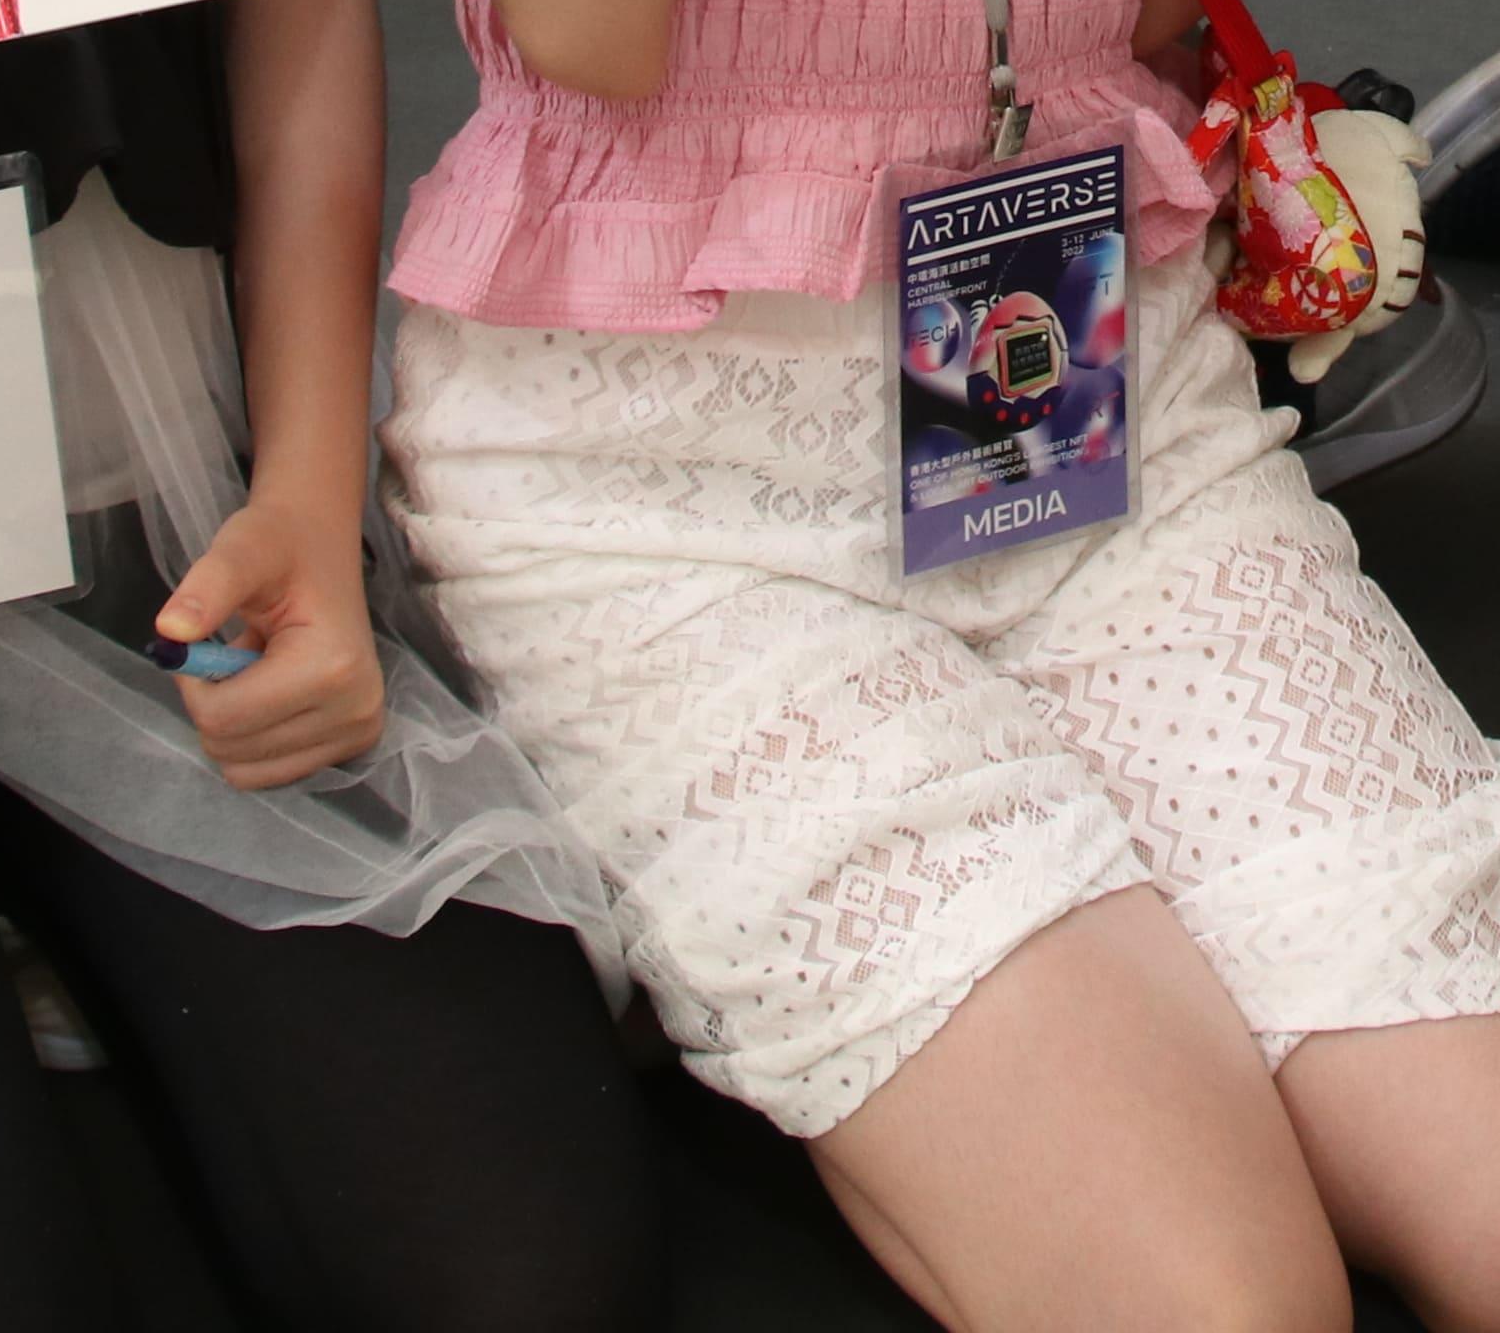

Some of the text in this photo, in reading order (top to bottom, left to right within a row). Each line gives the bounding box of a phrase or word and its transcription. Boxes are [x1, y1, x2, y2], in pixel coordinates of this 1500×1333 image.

[908, 171, 1115, 250] ARTAVERSE
[1088, 229, 1114, 241] JUNE
[1062, 247, 1084, 258] 2022
[907, 280, 953, 298] CENTRAL
[907, 280, 988, 310] HARBOURFRONT
[1023, 438, 1067, 459] LEST
[978, 464, 1028, 484] OUTDOOR
[964, 490, 1067, 543] MEDIA
